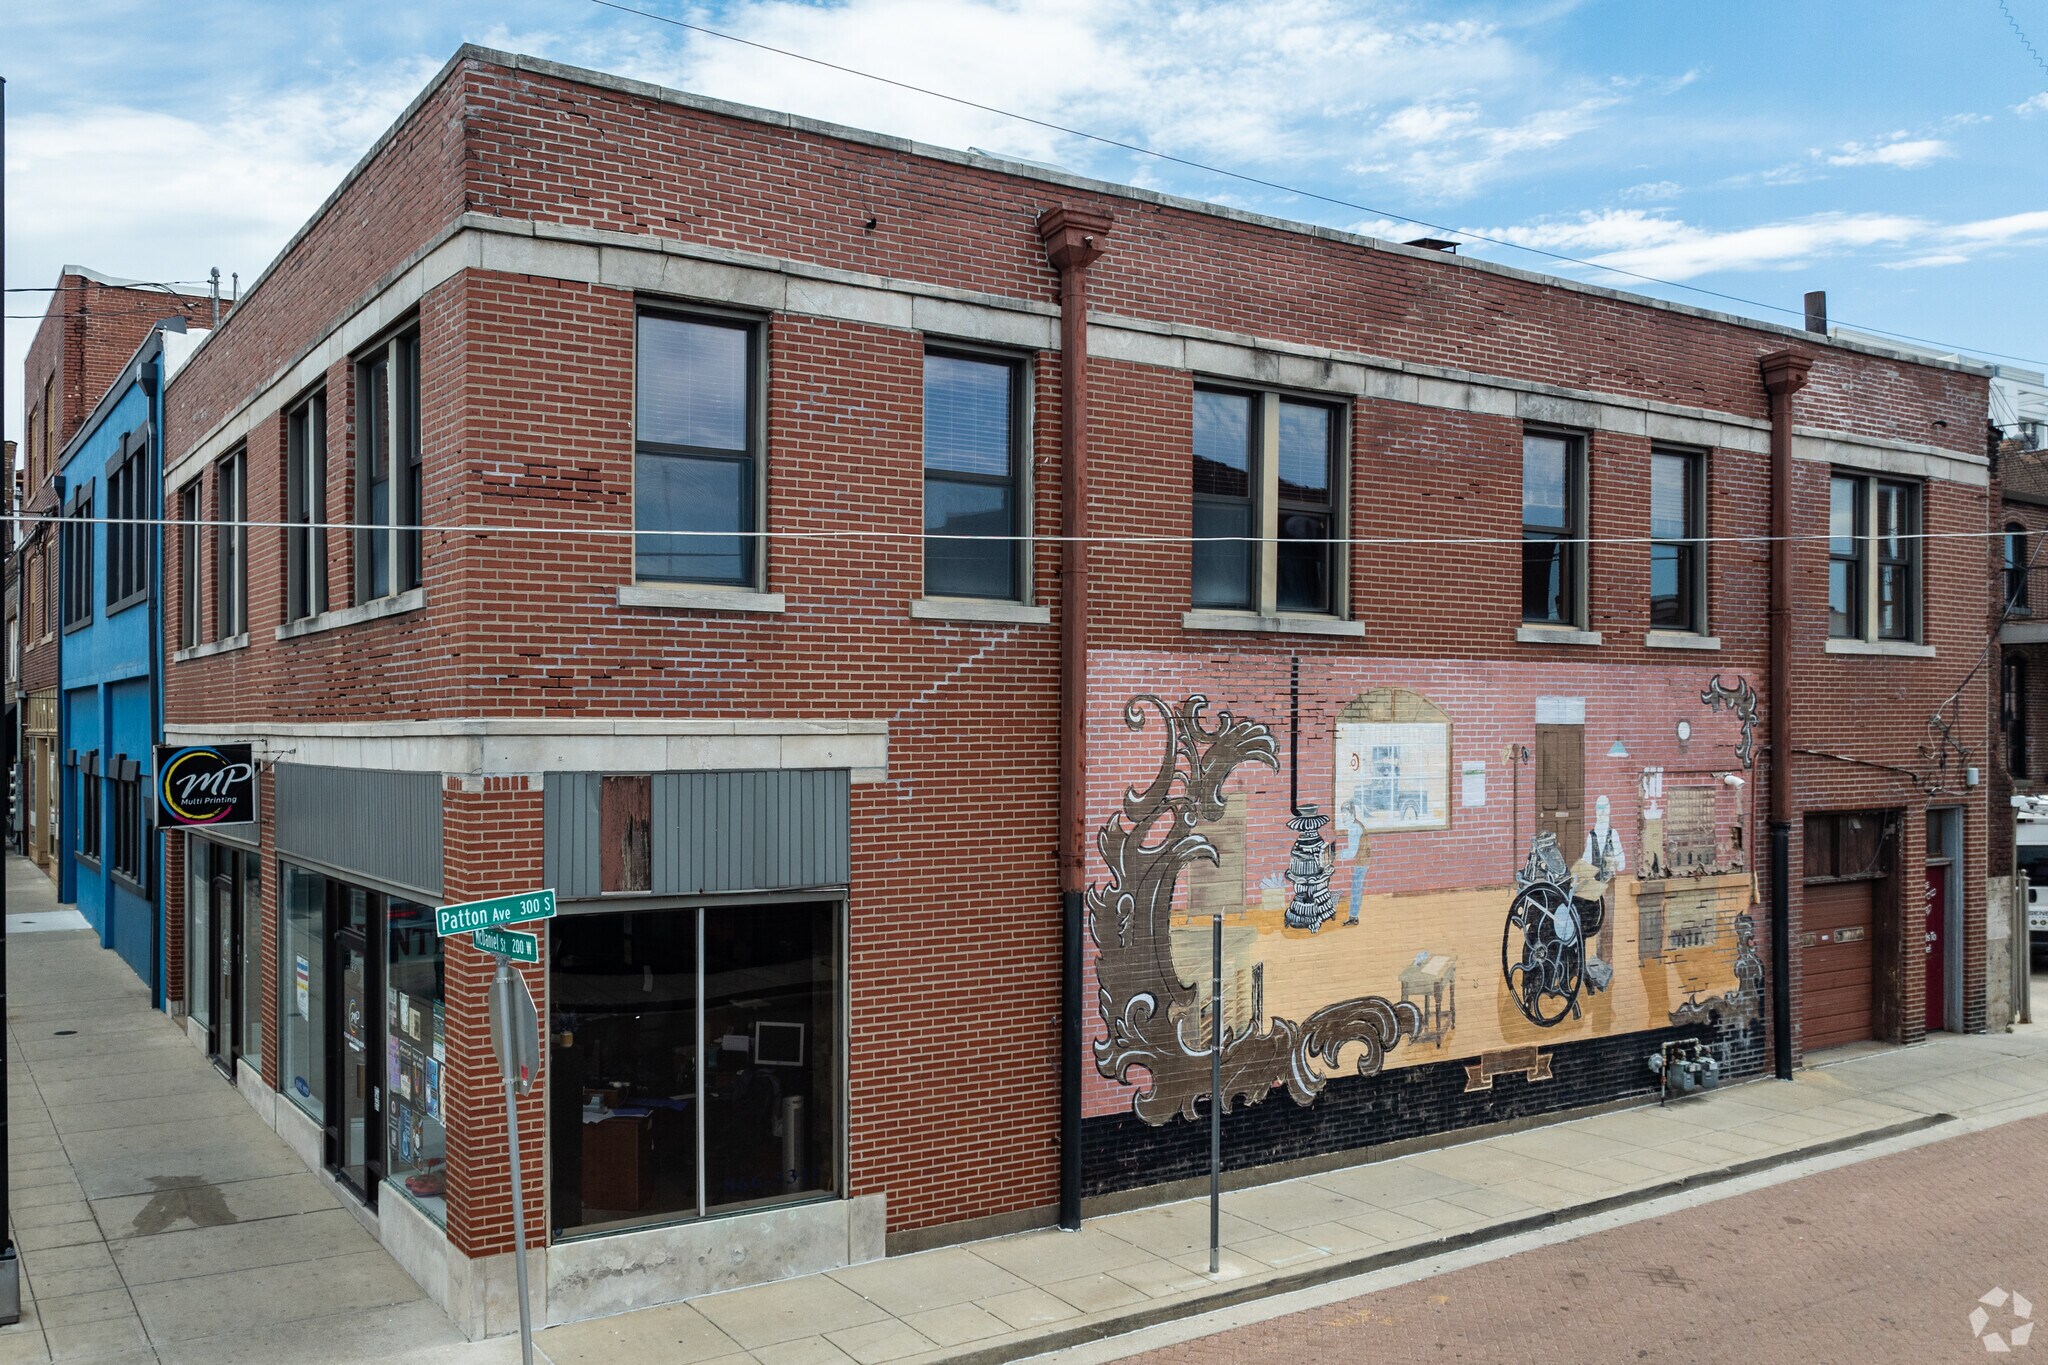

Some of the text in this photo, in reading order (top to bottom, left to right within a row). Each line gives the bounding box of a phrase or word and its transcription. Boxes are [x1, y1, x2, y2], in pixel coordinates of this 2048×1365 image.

[175, 763, 252, 799] MP
[181, 796, 238, 806] Multi Printing
[441, 896, 551, 931] Patton Ave 300 S
[475, 929, 532, 956] McDaniel St 200 W
